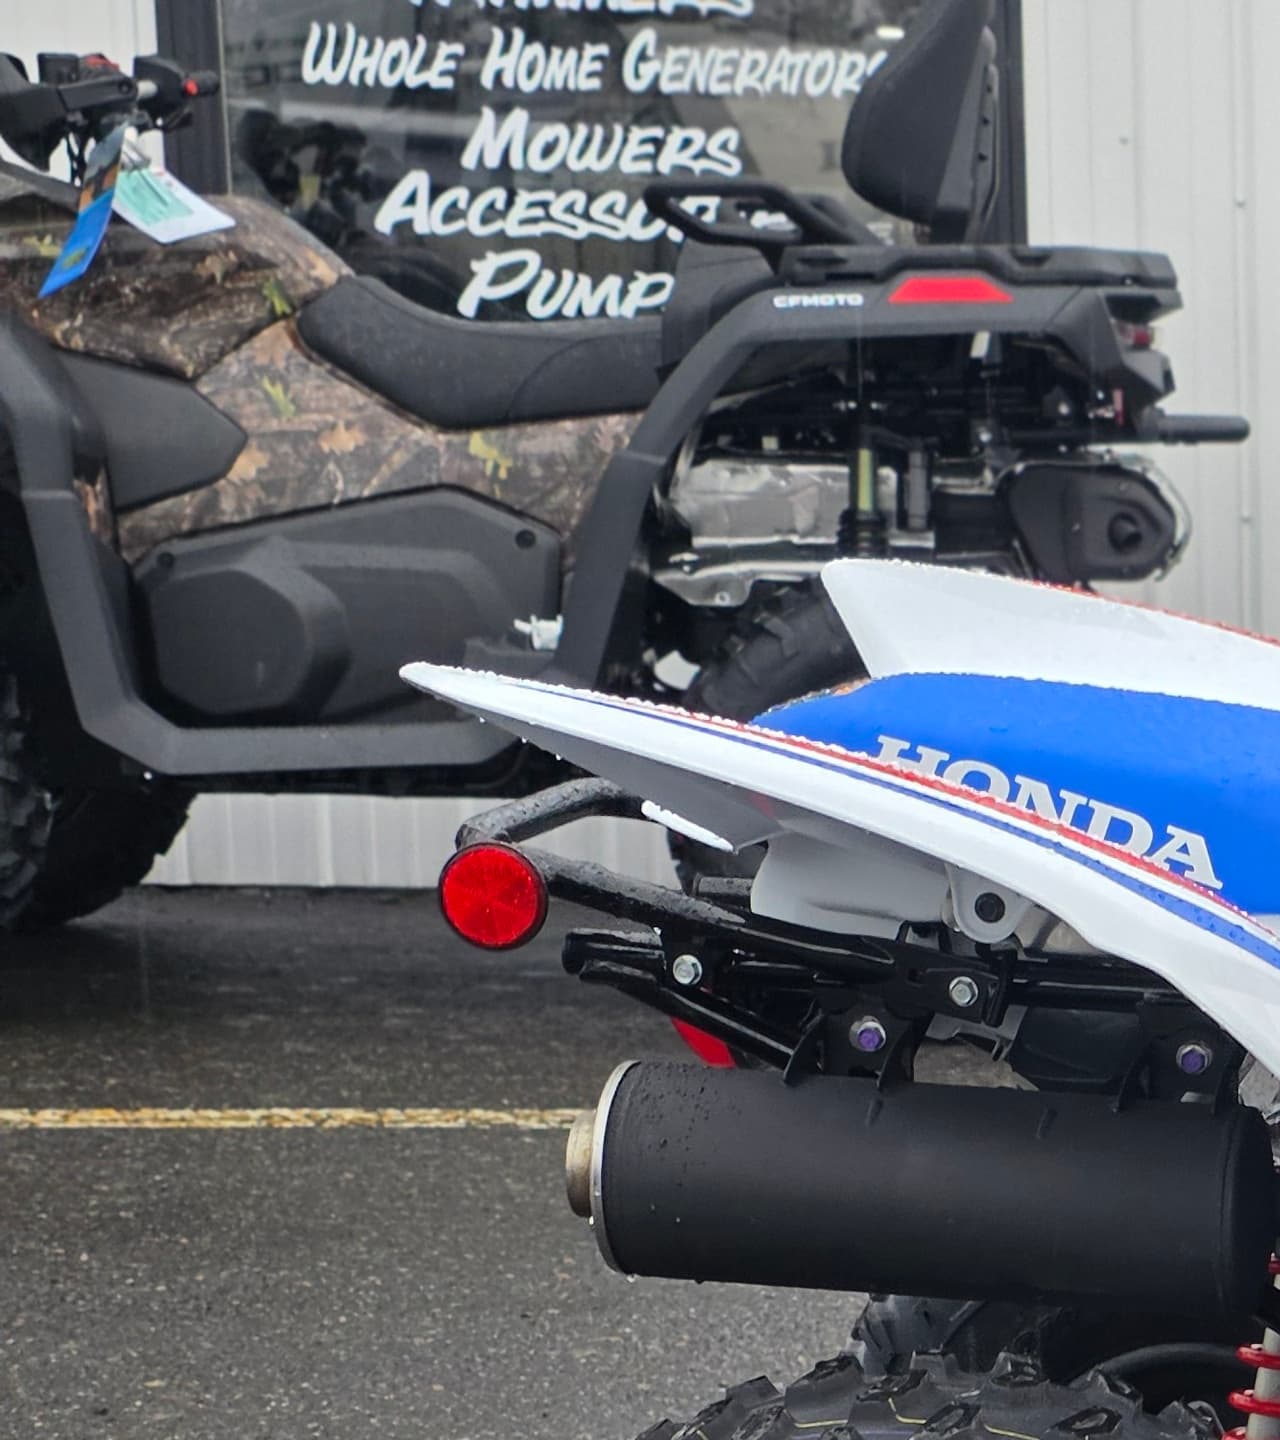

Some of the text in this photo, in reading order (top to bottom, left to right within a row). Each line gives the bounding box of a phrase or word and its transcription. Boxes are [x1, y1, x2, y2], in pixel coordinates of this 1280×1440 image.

[301, 21, 464, 90] WHOLE
[481, 27, 609, 94] HOME
[461, 105, 744, 178] MOWERS
[773, 293, 864, 308] CFMOTO
[871, 735, 1224, 889] HONDA
